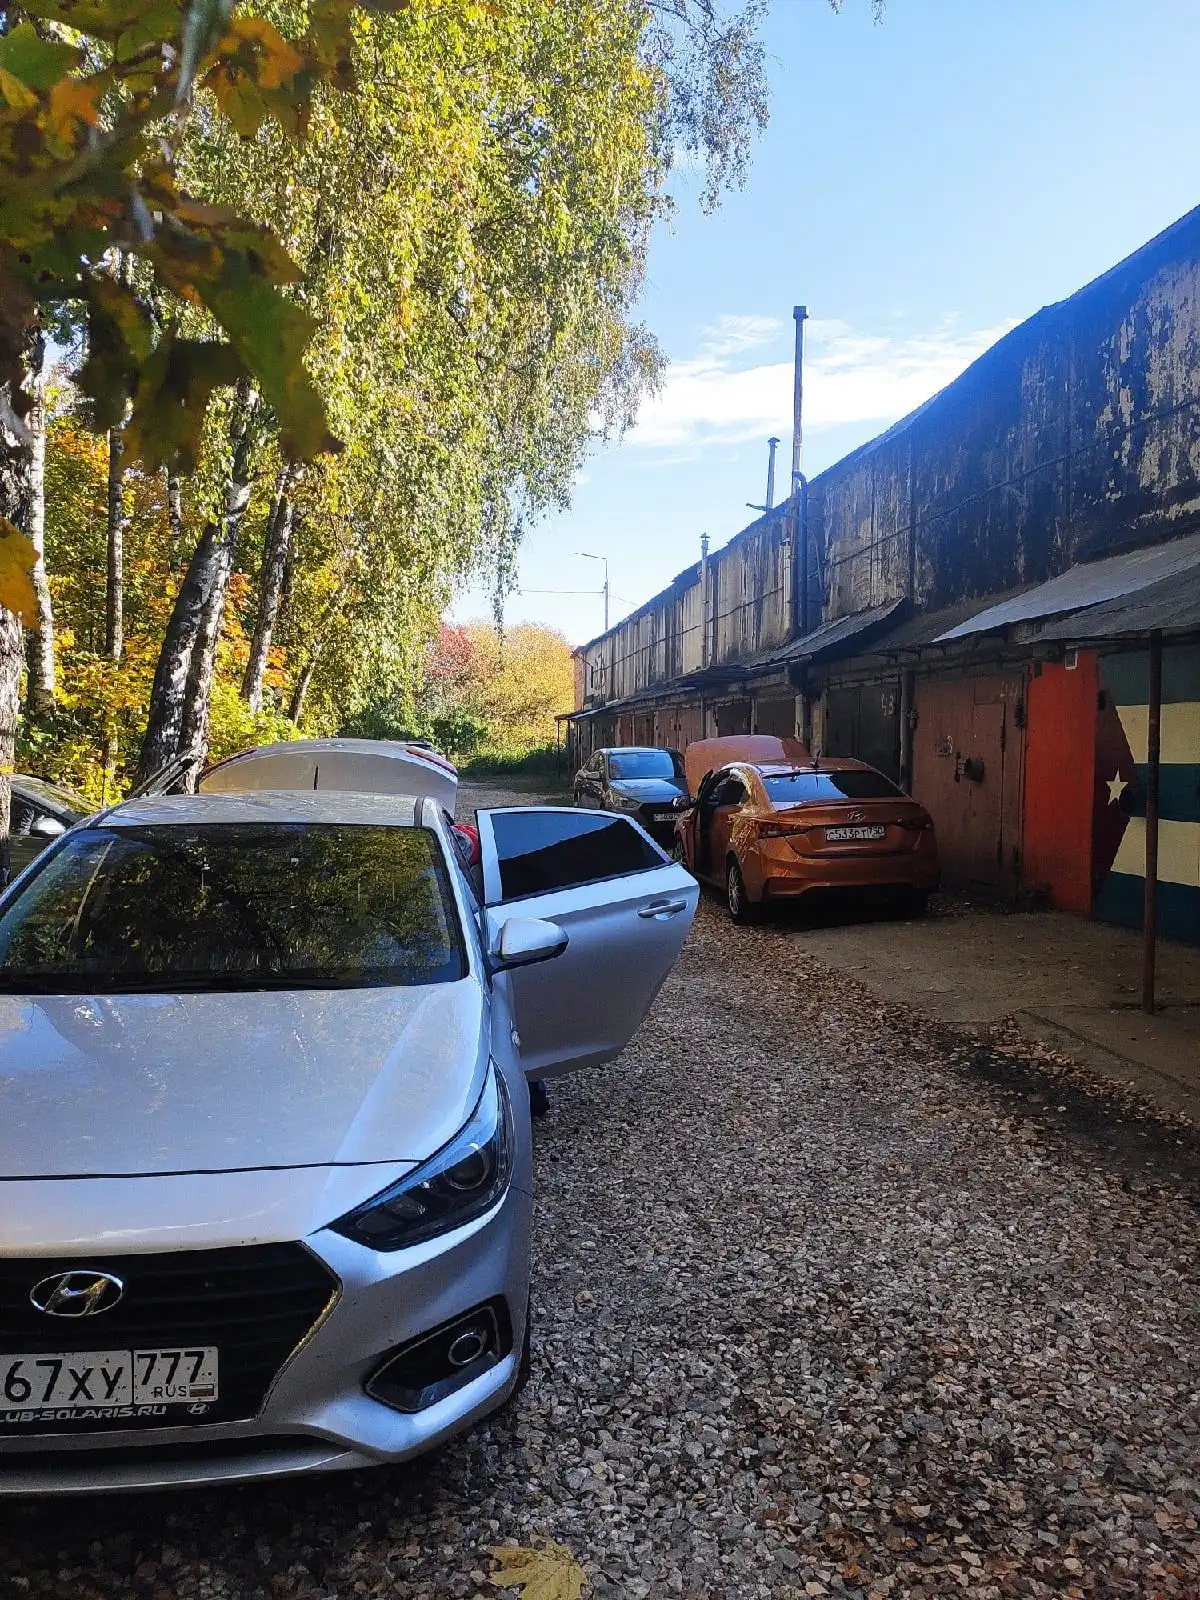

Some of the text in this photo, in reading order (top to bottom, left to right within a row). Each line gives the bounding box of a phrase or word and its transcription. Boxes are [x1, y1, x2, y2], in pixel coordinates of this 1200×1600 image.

[881, 693, 894, 716] 43
[137, 1350, 205, 1386] 777
[153, 1385, 187, 1398] RUS
